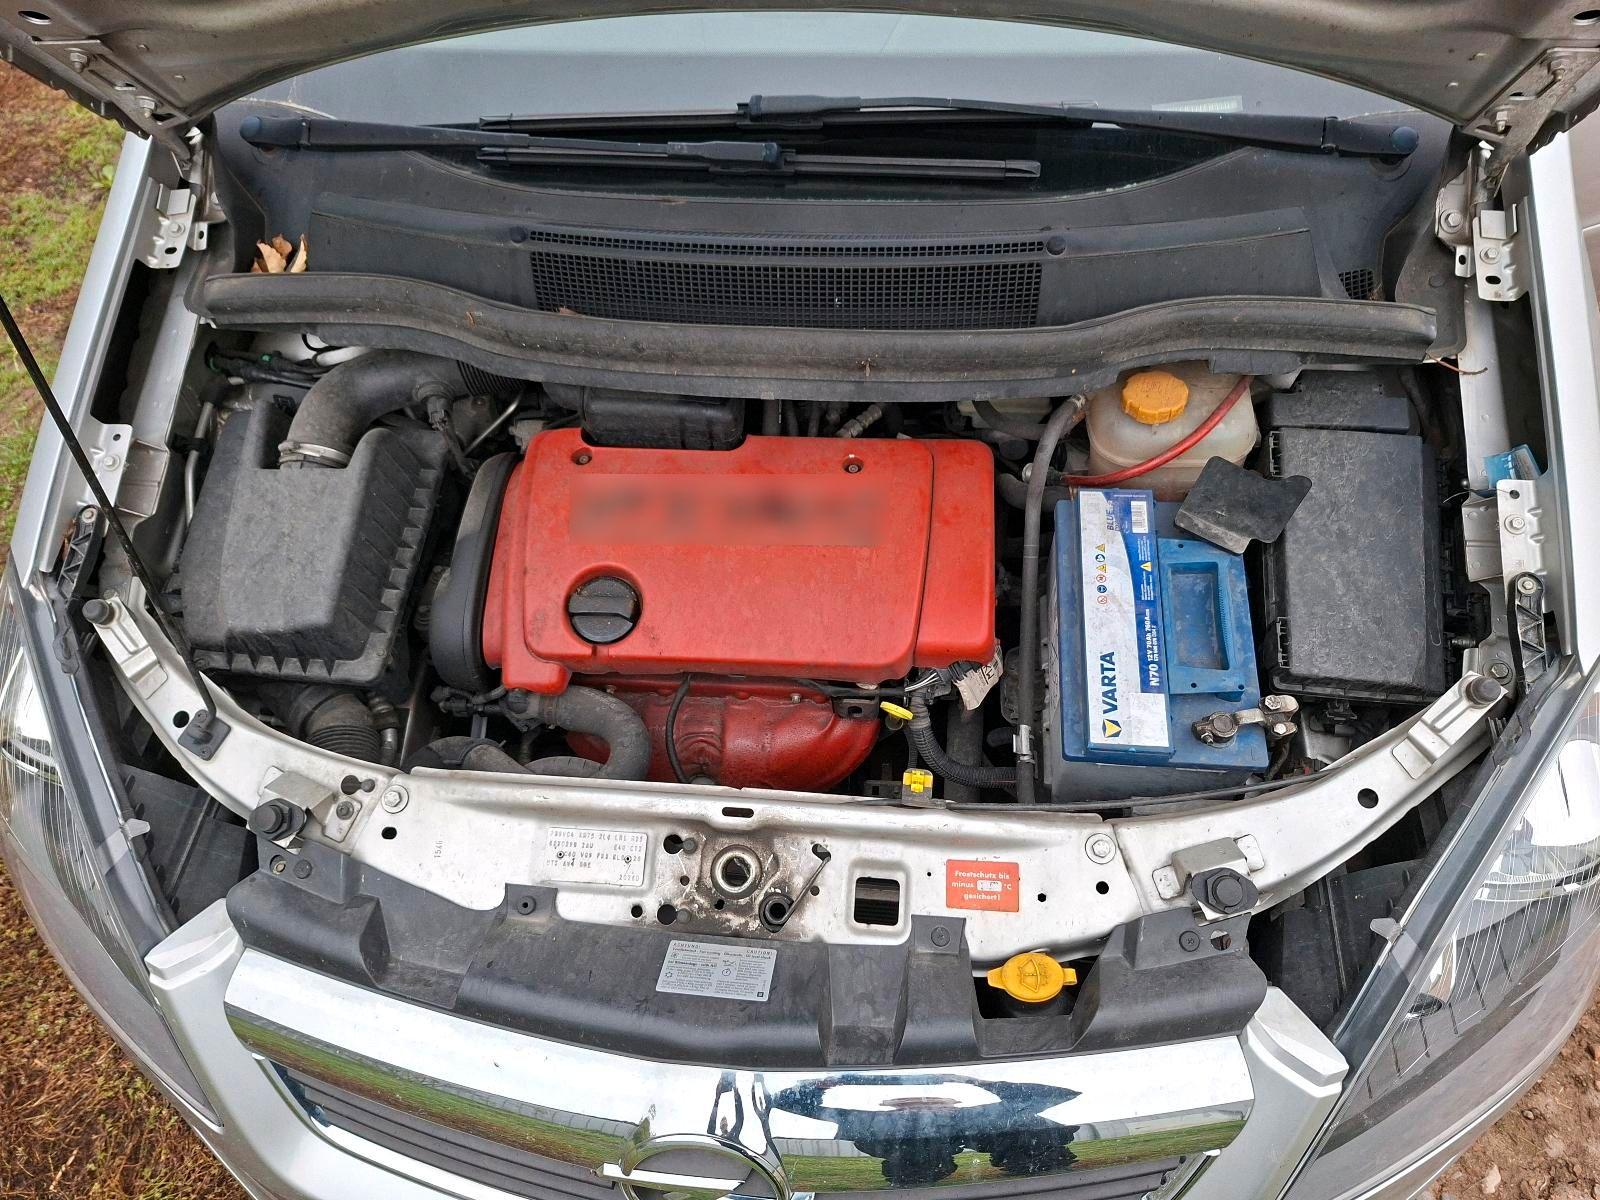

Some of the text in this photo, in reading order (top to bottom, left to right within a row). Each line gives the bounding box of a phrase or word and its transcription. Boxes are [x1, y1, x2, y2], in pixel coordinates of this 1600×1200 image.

[1148, 663, 1160, 687] N70
[1100, 651, 1118, 715] VARTA
[955, 870, 997, 879] Frostschutz
[951, 881, 974, 889] minus
[963, 892, 1001, 900] gesichert!
